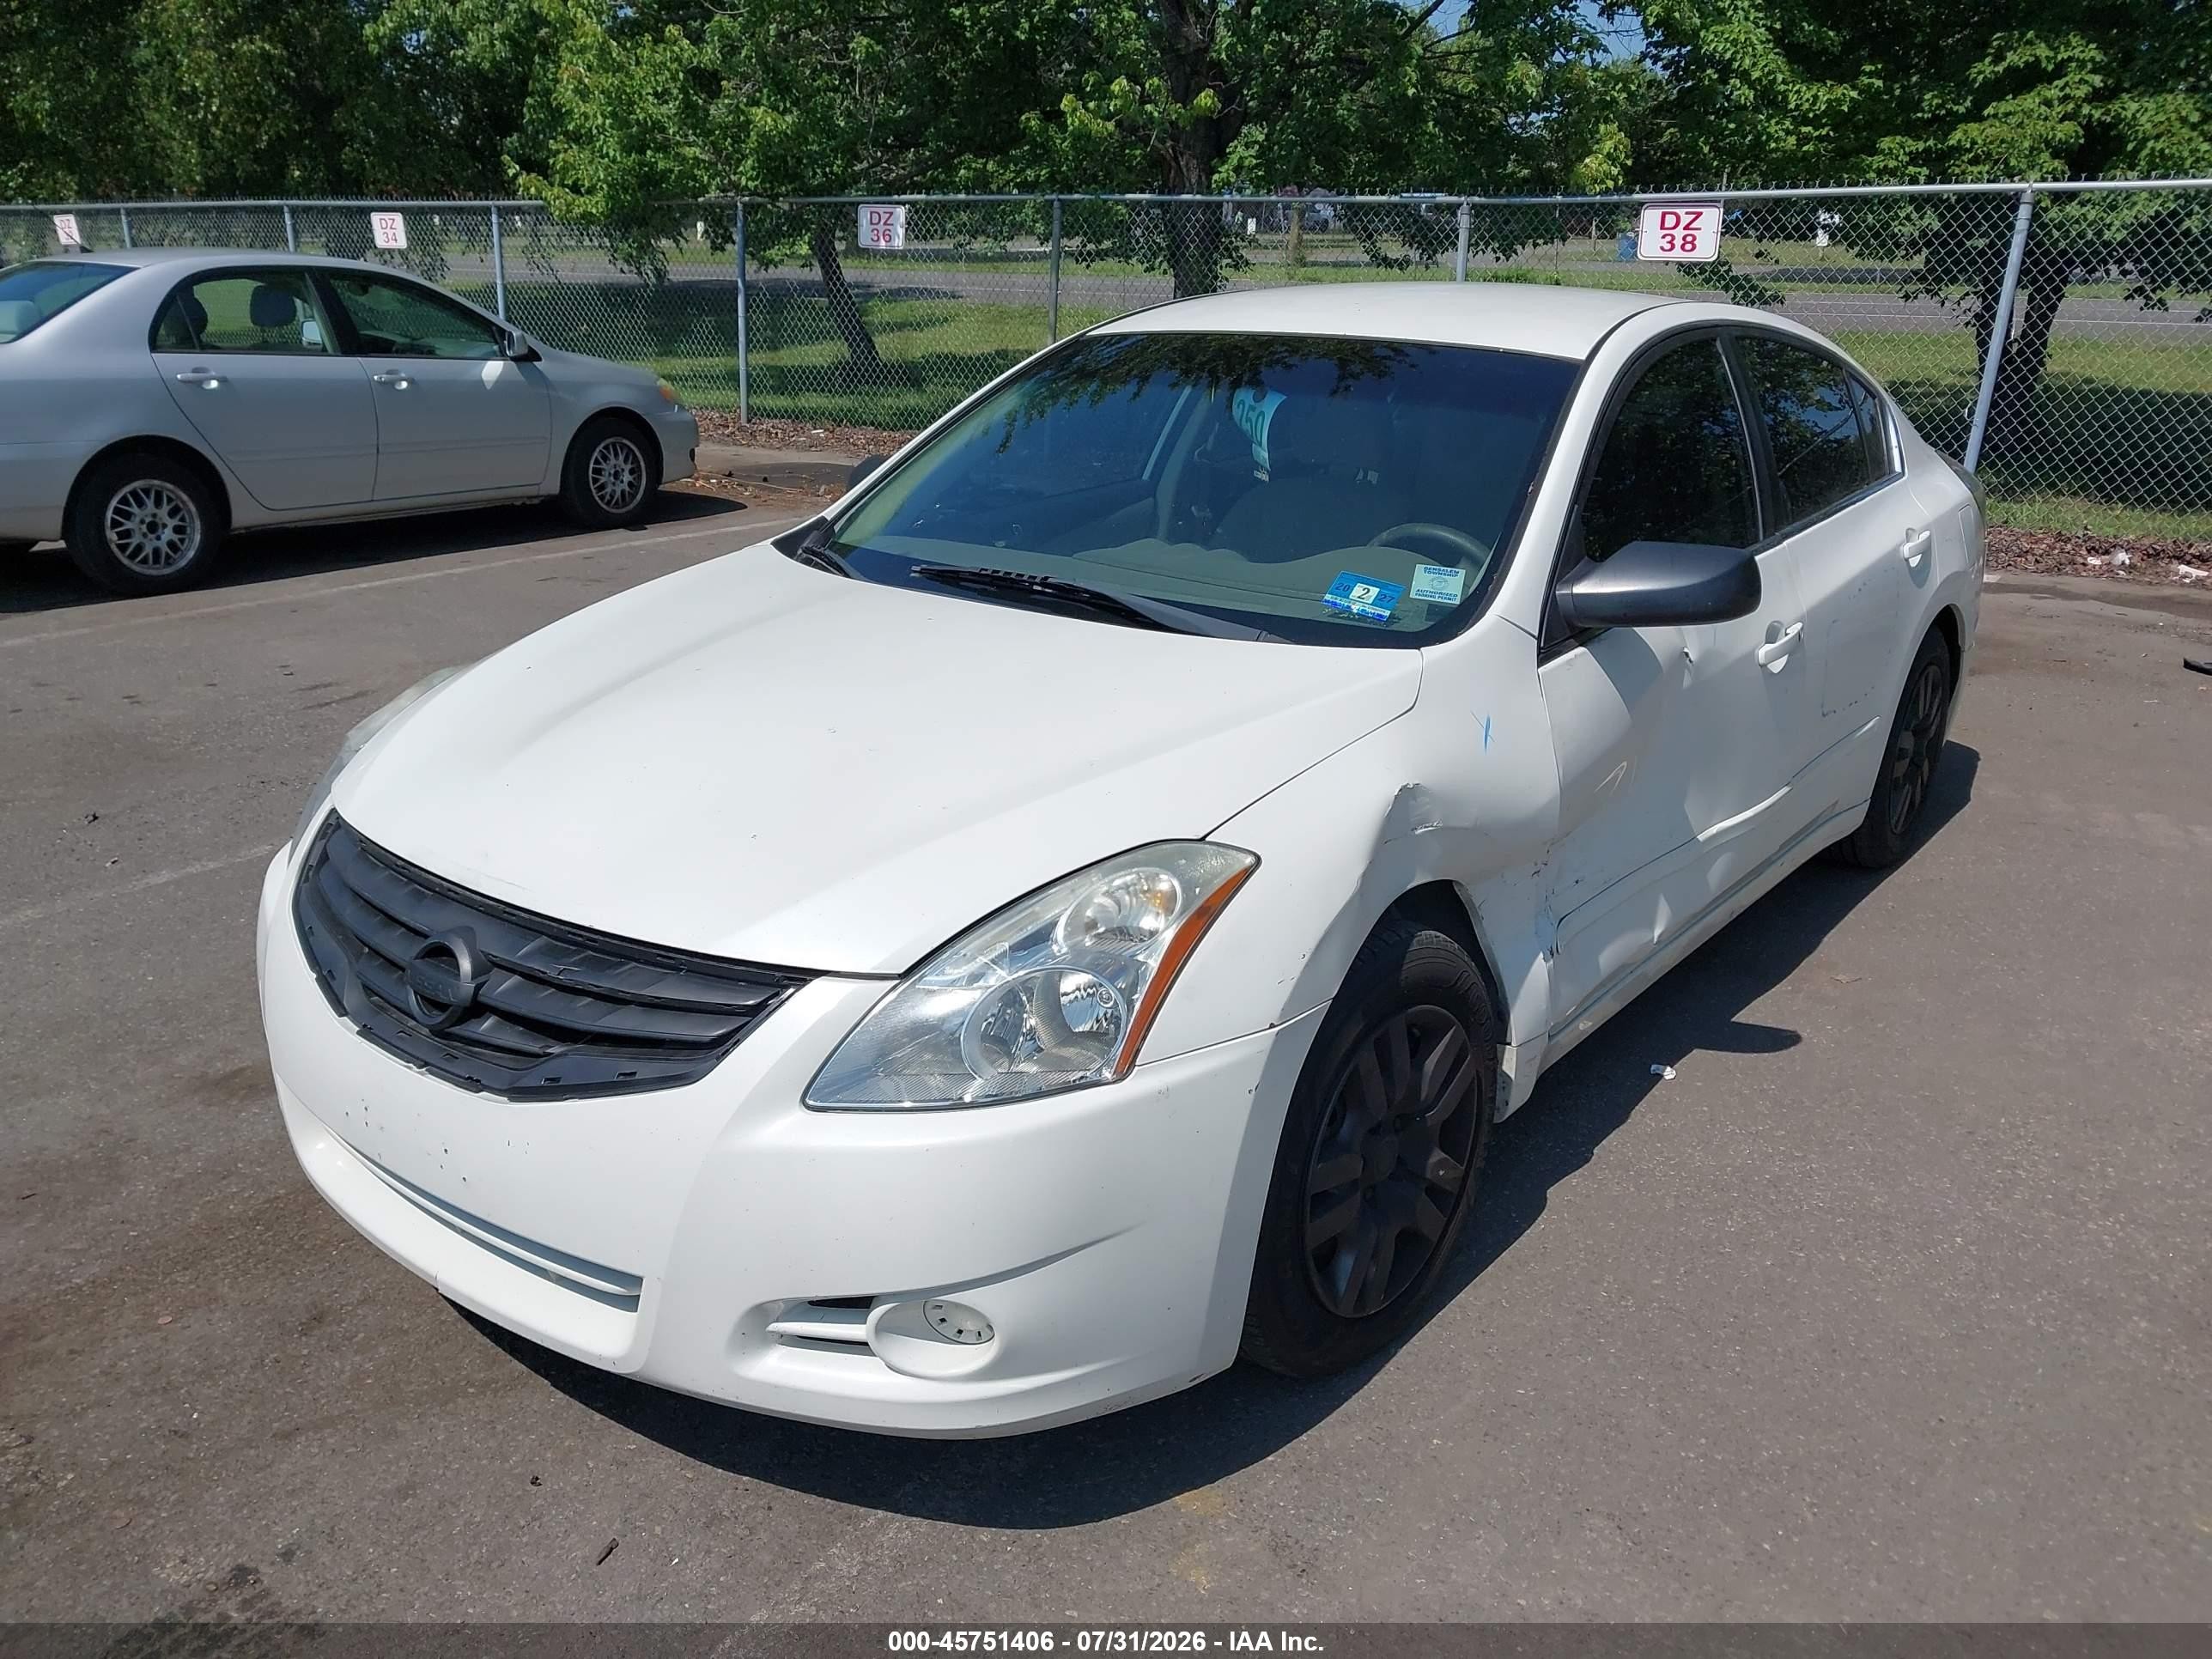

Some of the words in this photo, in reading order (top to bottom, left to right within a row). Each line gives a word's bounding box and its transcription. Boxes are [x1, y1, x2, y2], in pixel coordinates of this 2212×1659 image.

[379, 218, 398, 230] DZ
[870, 211, 894, 226] DZ
[1659, 210, 1705, 231] DZ
[382, 232, 398, 244] 34
[871, 228, 892, 243] 36
[1659, 233, 1698, 252] 38
[1335, 583, 1351, 592] 20
[1357, 587, 1370, 600] 2
[1377, 593, 1396, 604] 27
[1415, 588, 1458, 598] AUTHORIZED
